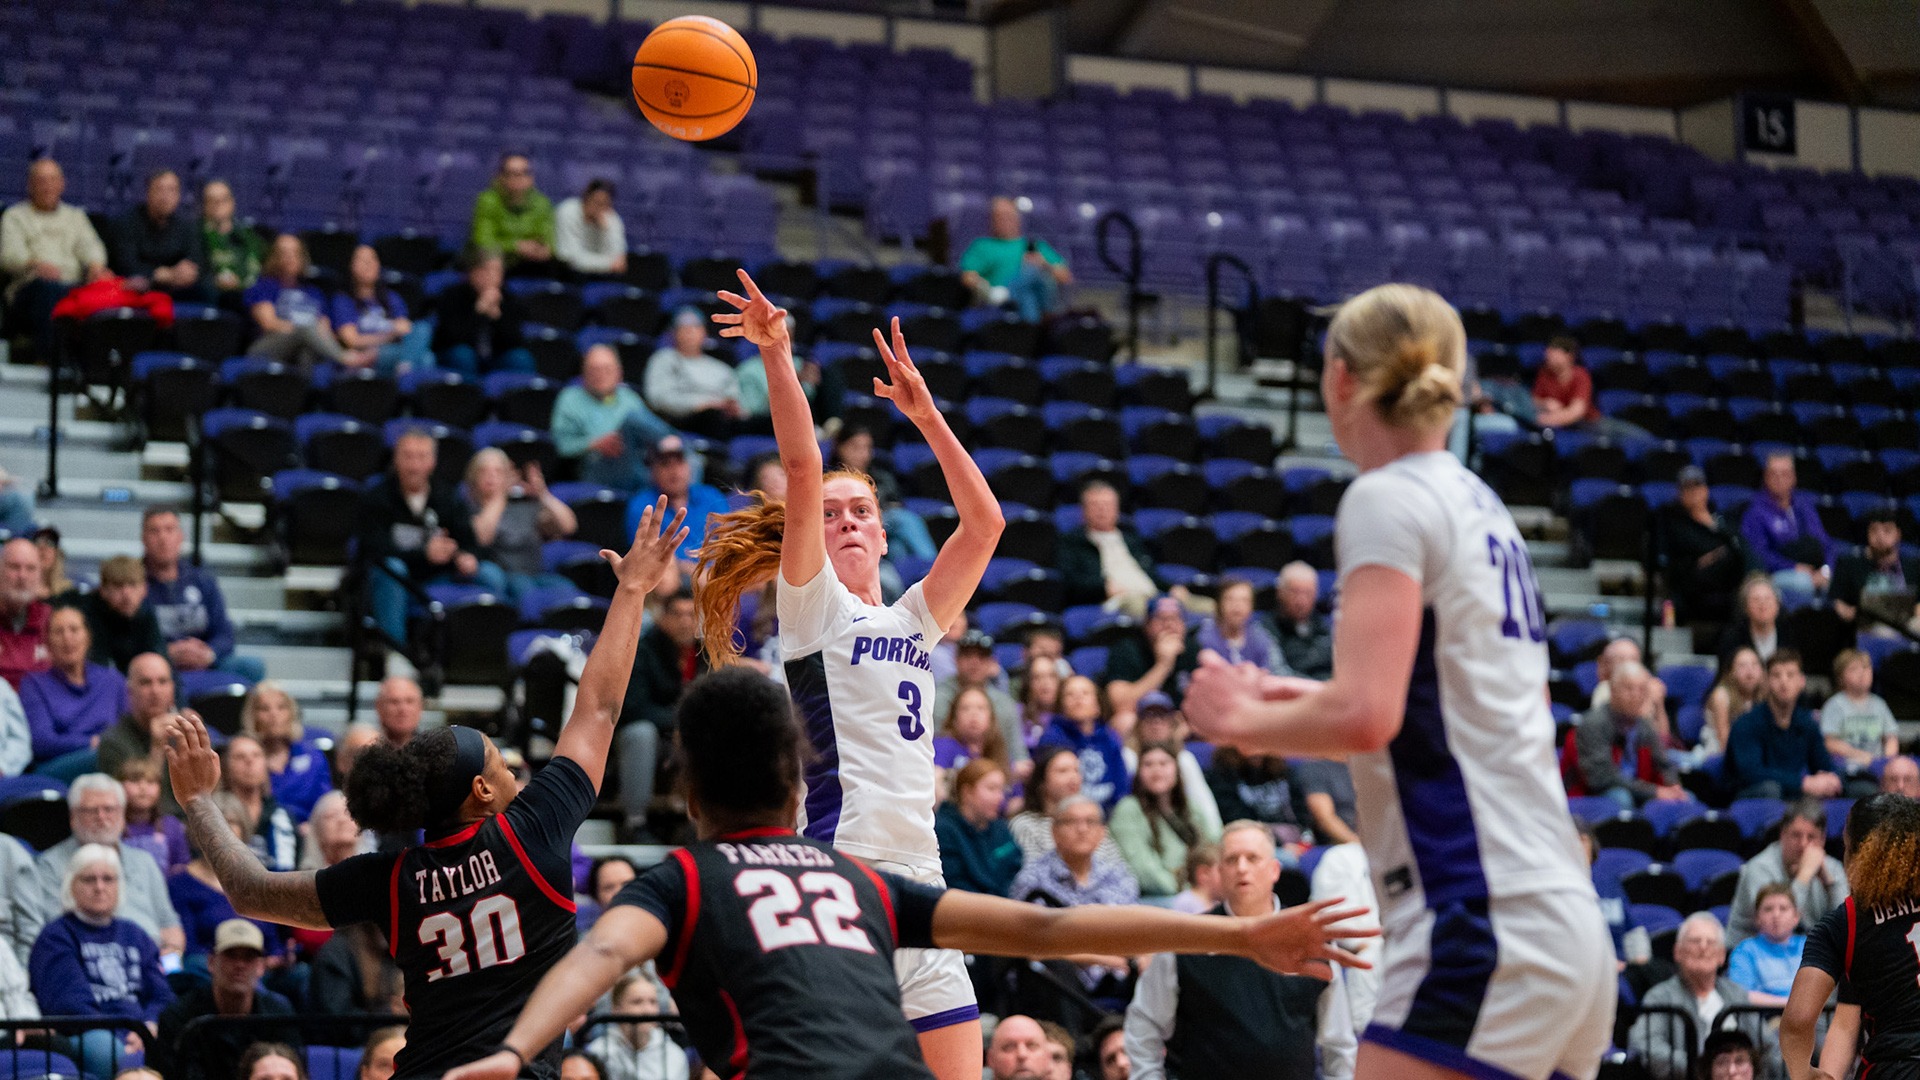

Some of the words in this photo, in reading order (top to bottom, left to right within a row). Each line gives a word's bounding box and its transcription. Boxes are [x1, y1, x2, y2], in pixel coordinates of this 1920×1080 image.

[897, 680, 925, 741] 3
[416, 849, 502, 904] TAYLOR
[733, 869, 877, 954] 22
[417, 891, 527, 983] 30
